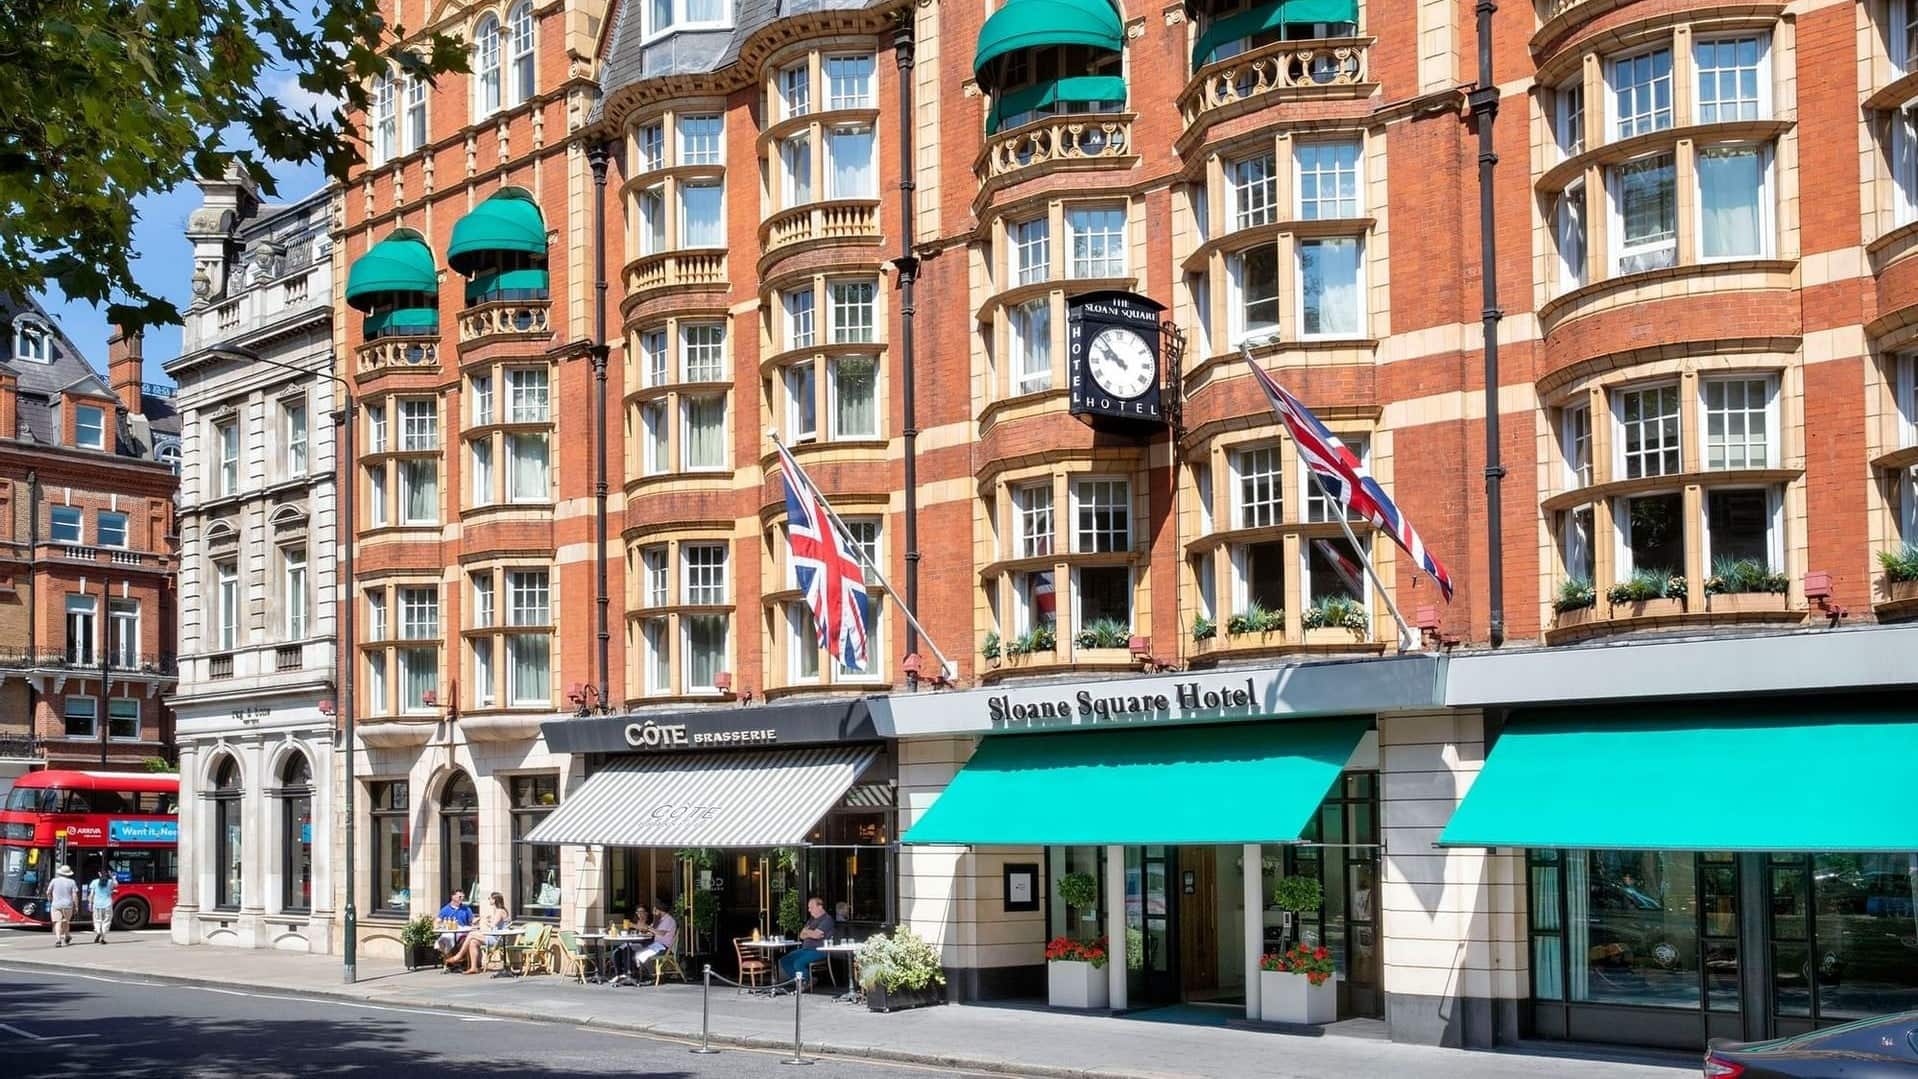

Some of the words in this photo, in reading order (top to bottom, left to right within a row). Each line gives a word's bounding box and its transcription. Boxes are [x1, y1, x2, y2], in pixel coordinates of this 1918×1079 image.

[1085, 304, 1118, 316] SLOANE
[1121, 308, 1155, 321] SQUARE
[1072, 326, 1081, 403] HOTEL
[1086, 396, 1157, 415] HOTEL
[988, 696, 1072, 721] Sloane
[1076, 691, 1169, 720] Square
[1175, 678, 1258, 710] Hotel
[624, 720, 689, 746] CÔTE
[693, 729, 777, 743] BRASSERIE
